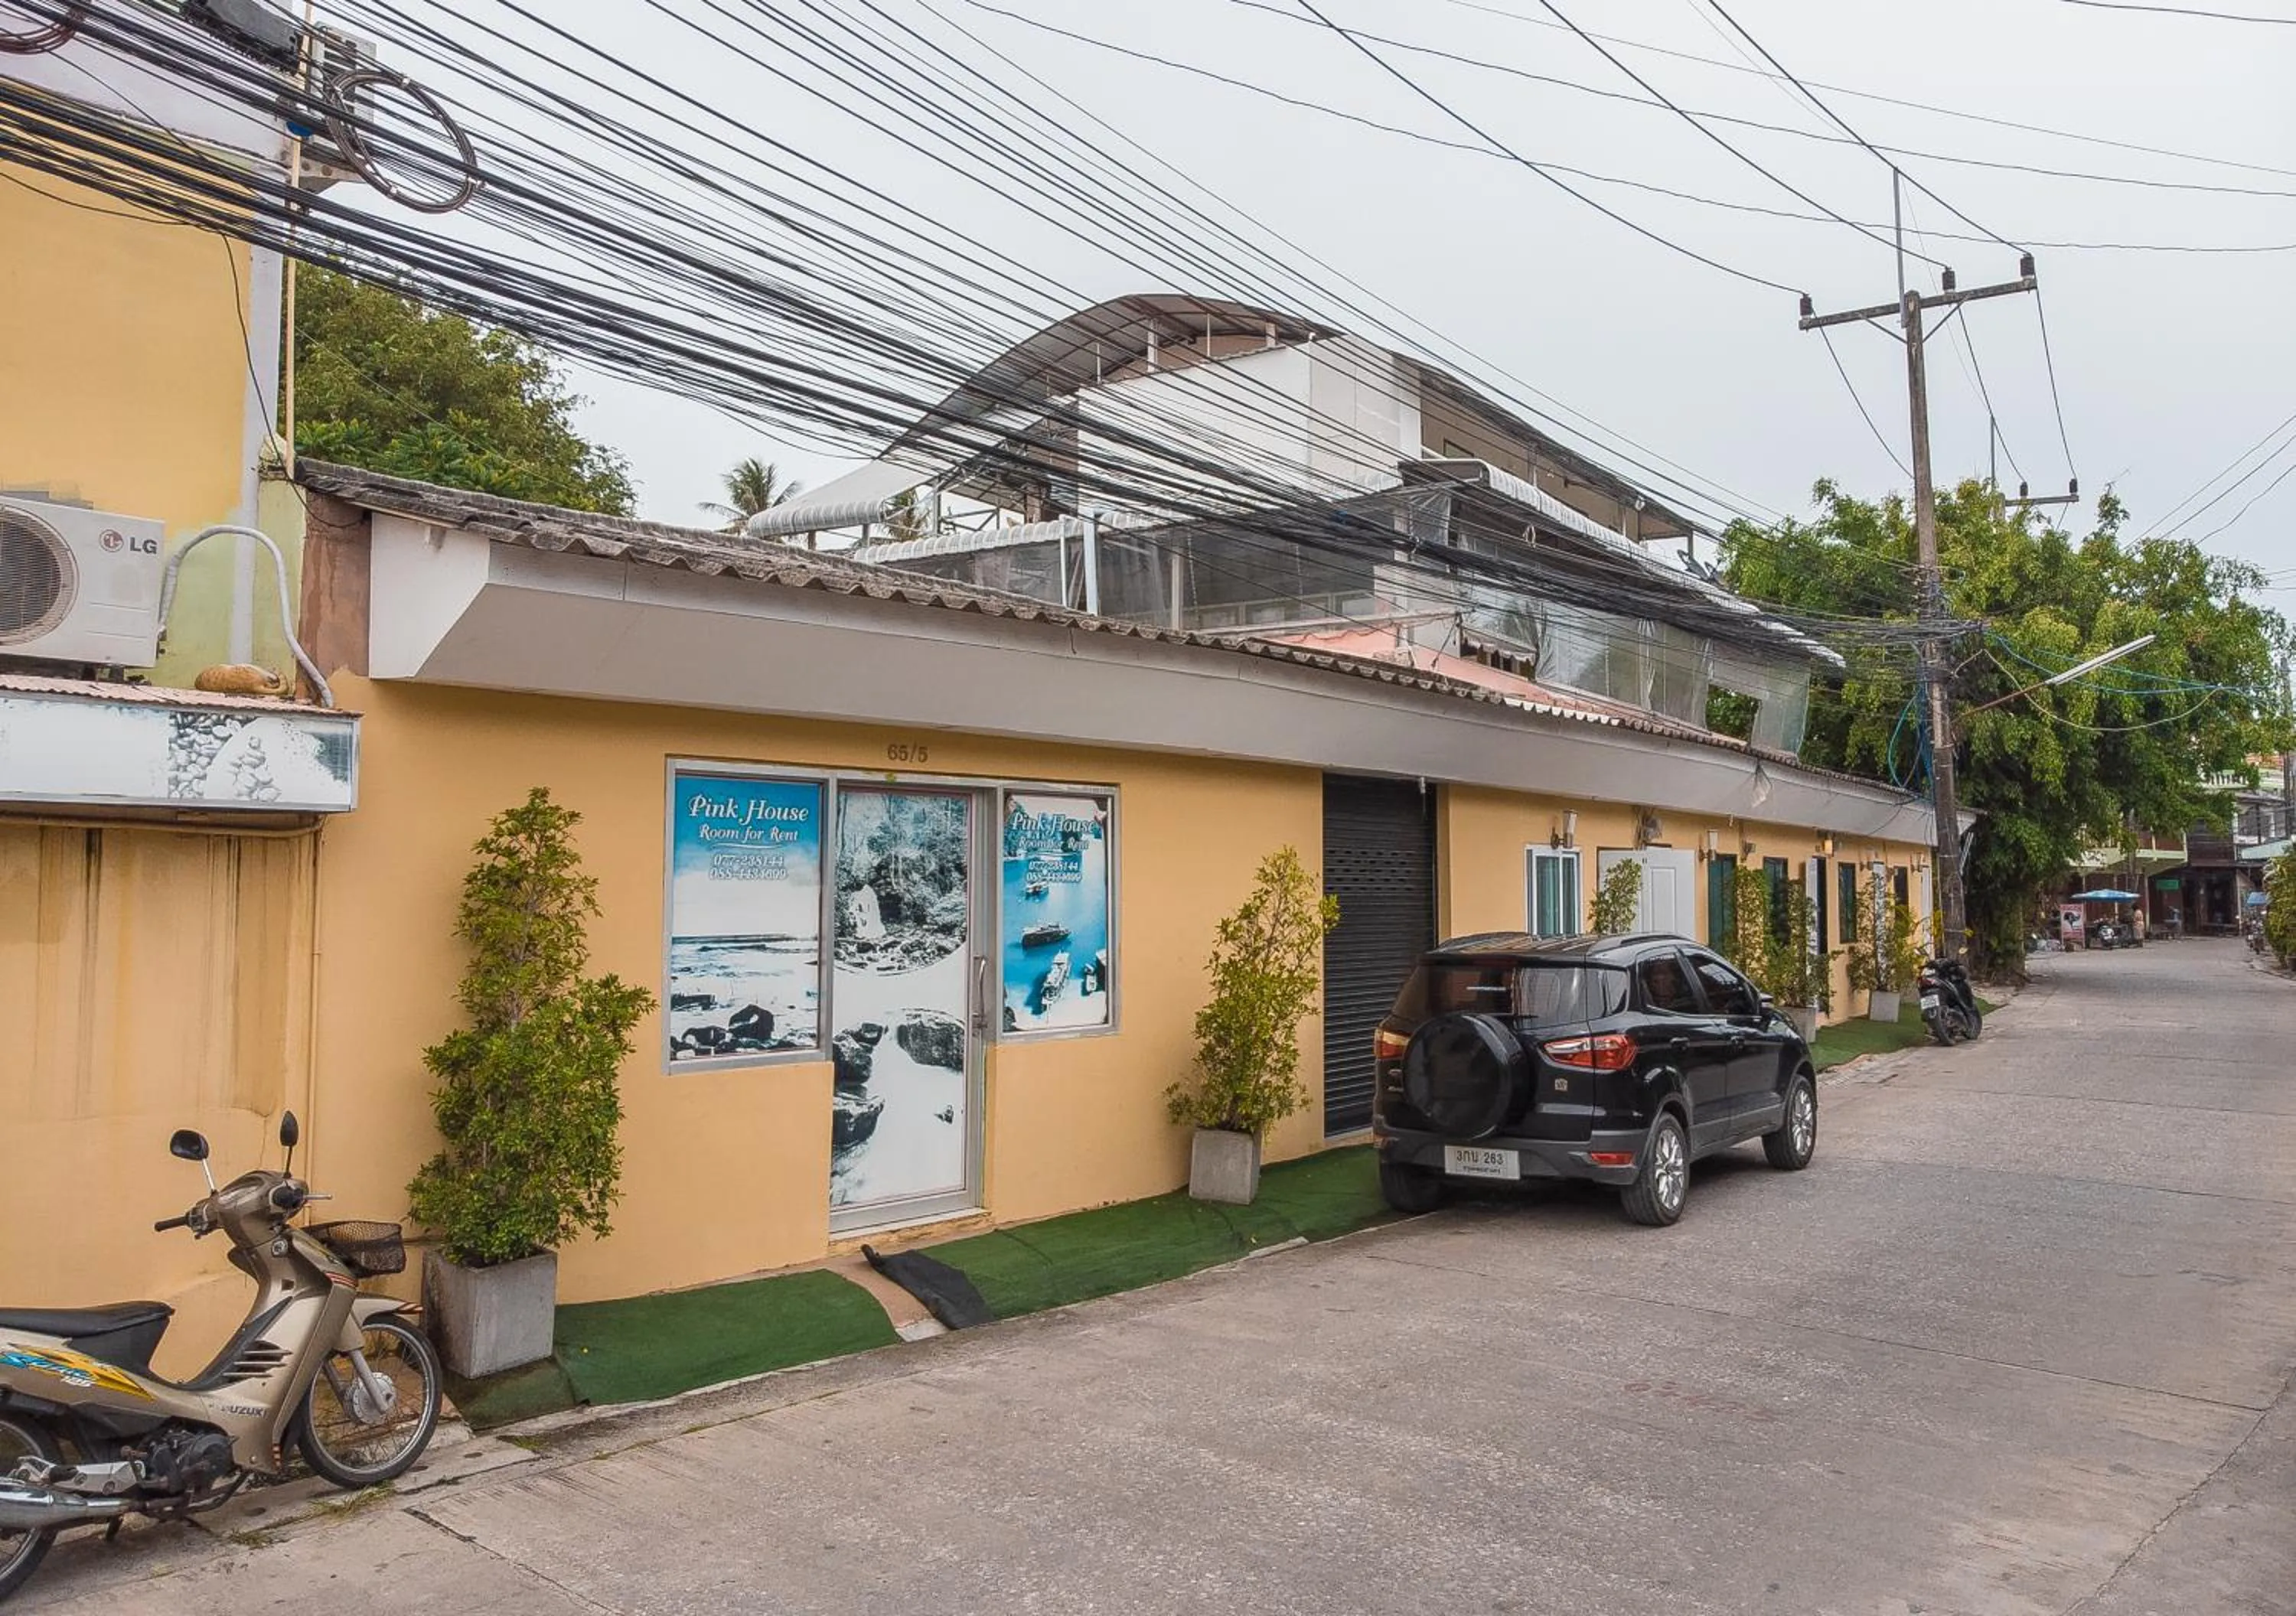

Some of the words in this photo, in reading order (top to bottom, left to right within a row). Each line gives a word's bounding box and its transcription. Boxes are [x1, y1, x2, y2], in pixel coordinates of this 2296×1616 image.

[130, 536, 158, 554] LG
[688, 794, 739, 818] Pink
[739, 800, 809, 826] House
[700, 823, 739, 840] Room
[743, 826, 764, 843] for
[770, 826, 799, 842] Rent
[1011, 812, 1049, 831] Pink
[1047, 813, 1099, 836] House
